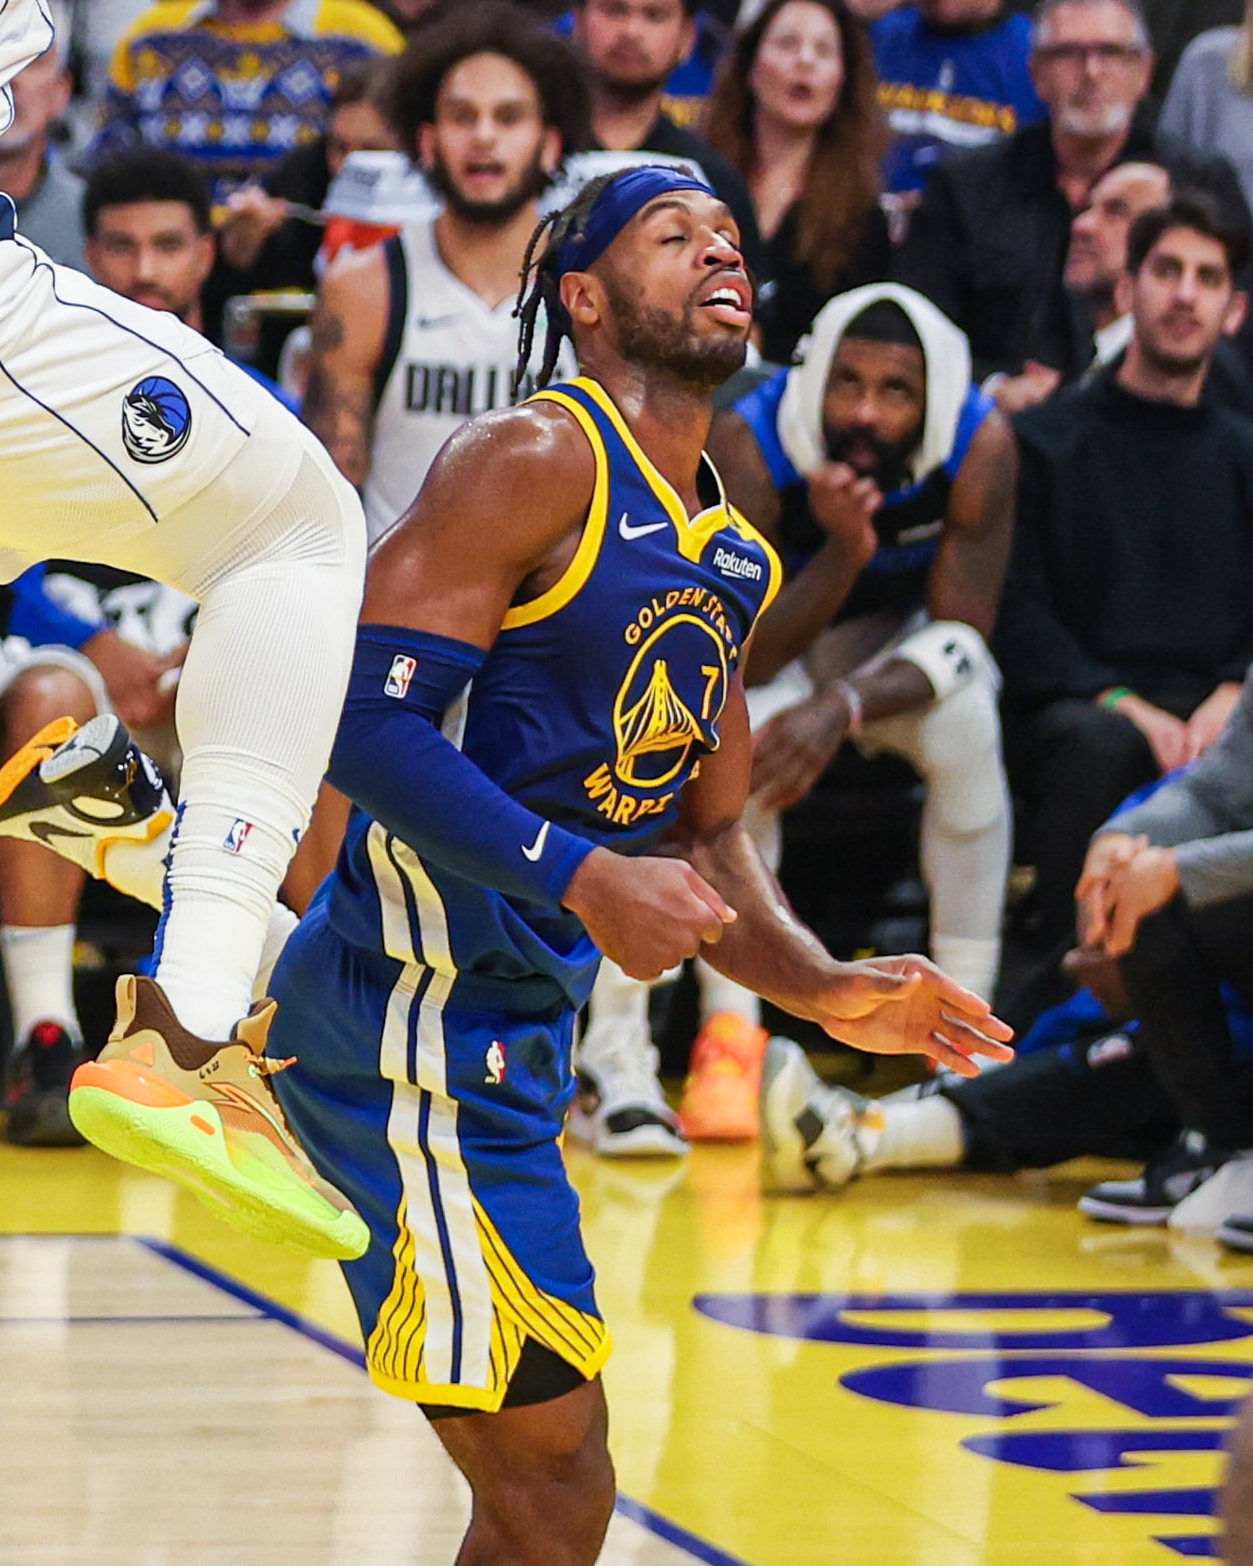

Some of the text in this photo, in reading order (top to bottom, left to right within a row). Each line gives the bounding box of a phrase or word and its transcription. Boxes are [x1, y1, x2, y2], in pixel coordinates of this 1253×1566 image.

[713, 547, 763, 581] Rakuten
[624, 587, 708, 645] GOLDEN
[700, 665, 720, 719] 7
